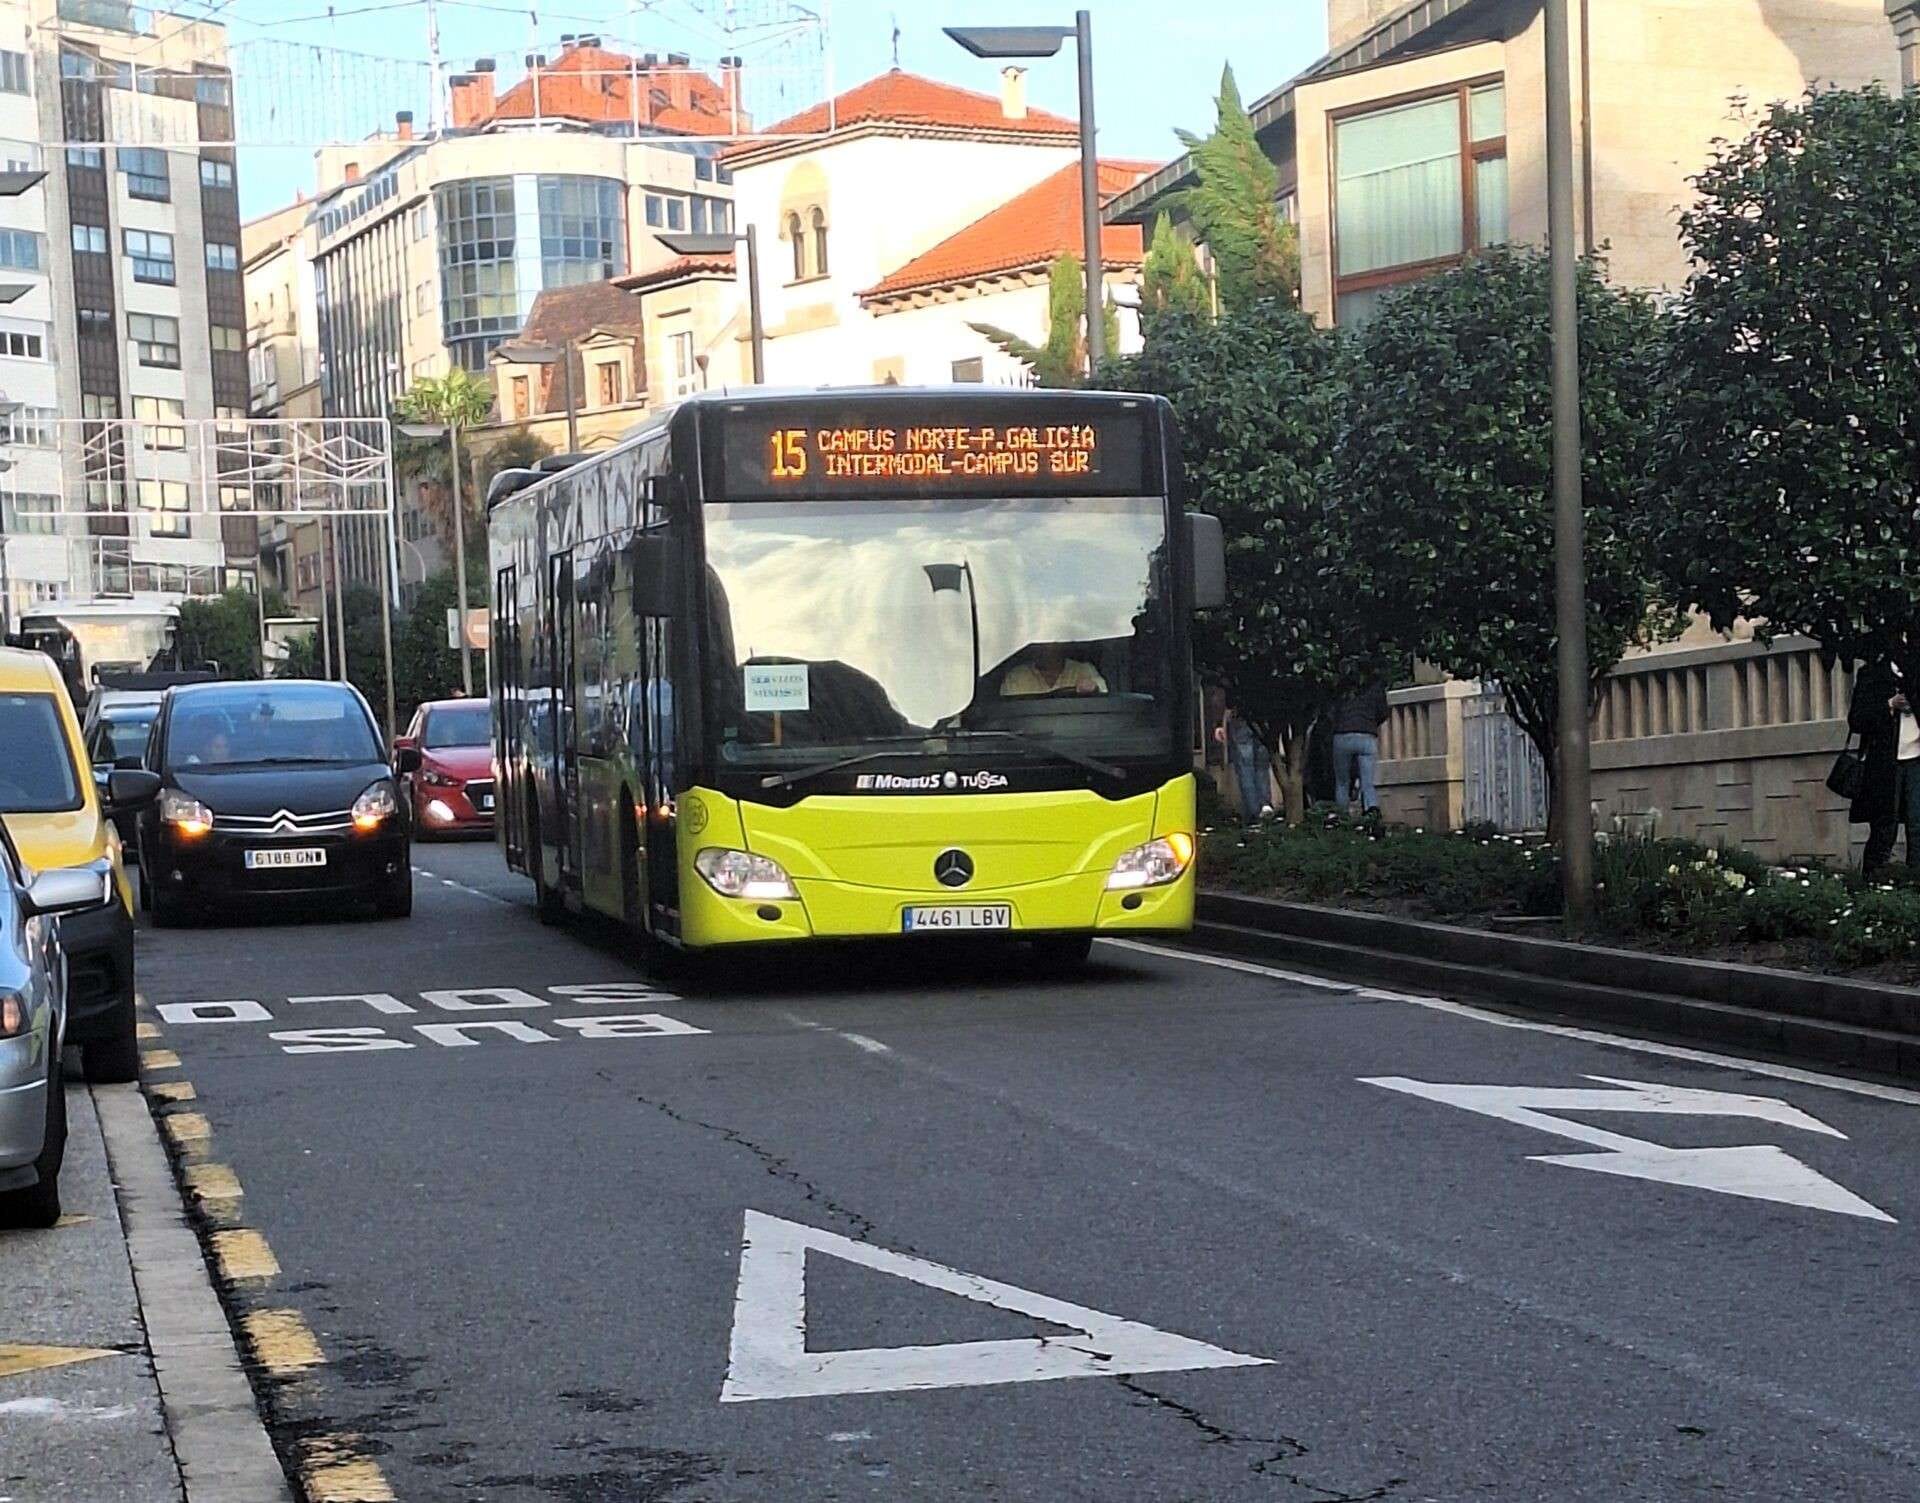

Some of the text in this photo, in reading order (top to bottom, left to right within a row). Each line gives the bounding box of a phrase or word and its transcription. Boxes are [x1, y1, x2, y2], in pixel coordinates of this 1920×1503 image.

[817, 428, 896, 450] CAMPUS
[771, 429, 807, 476] 15
[826, 450, 1089, 475] INTERMODAL-CAMPUS SUR
[961, 771, 1008, 789] TUSSA
[917, 908, 1005, 926] 4461 LBV
[156, 982, 683, 1023] SOLO
[269, 1013, 711, 1054] BUS
